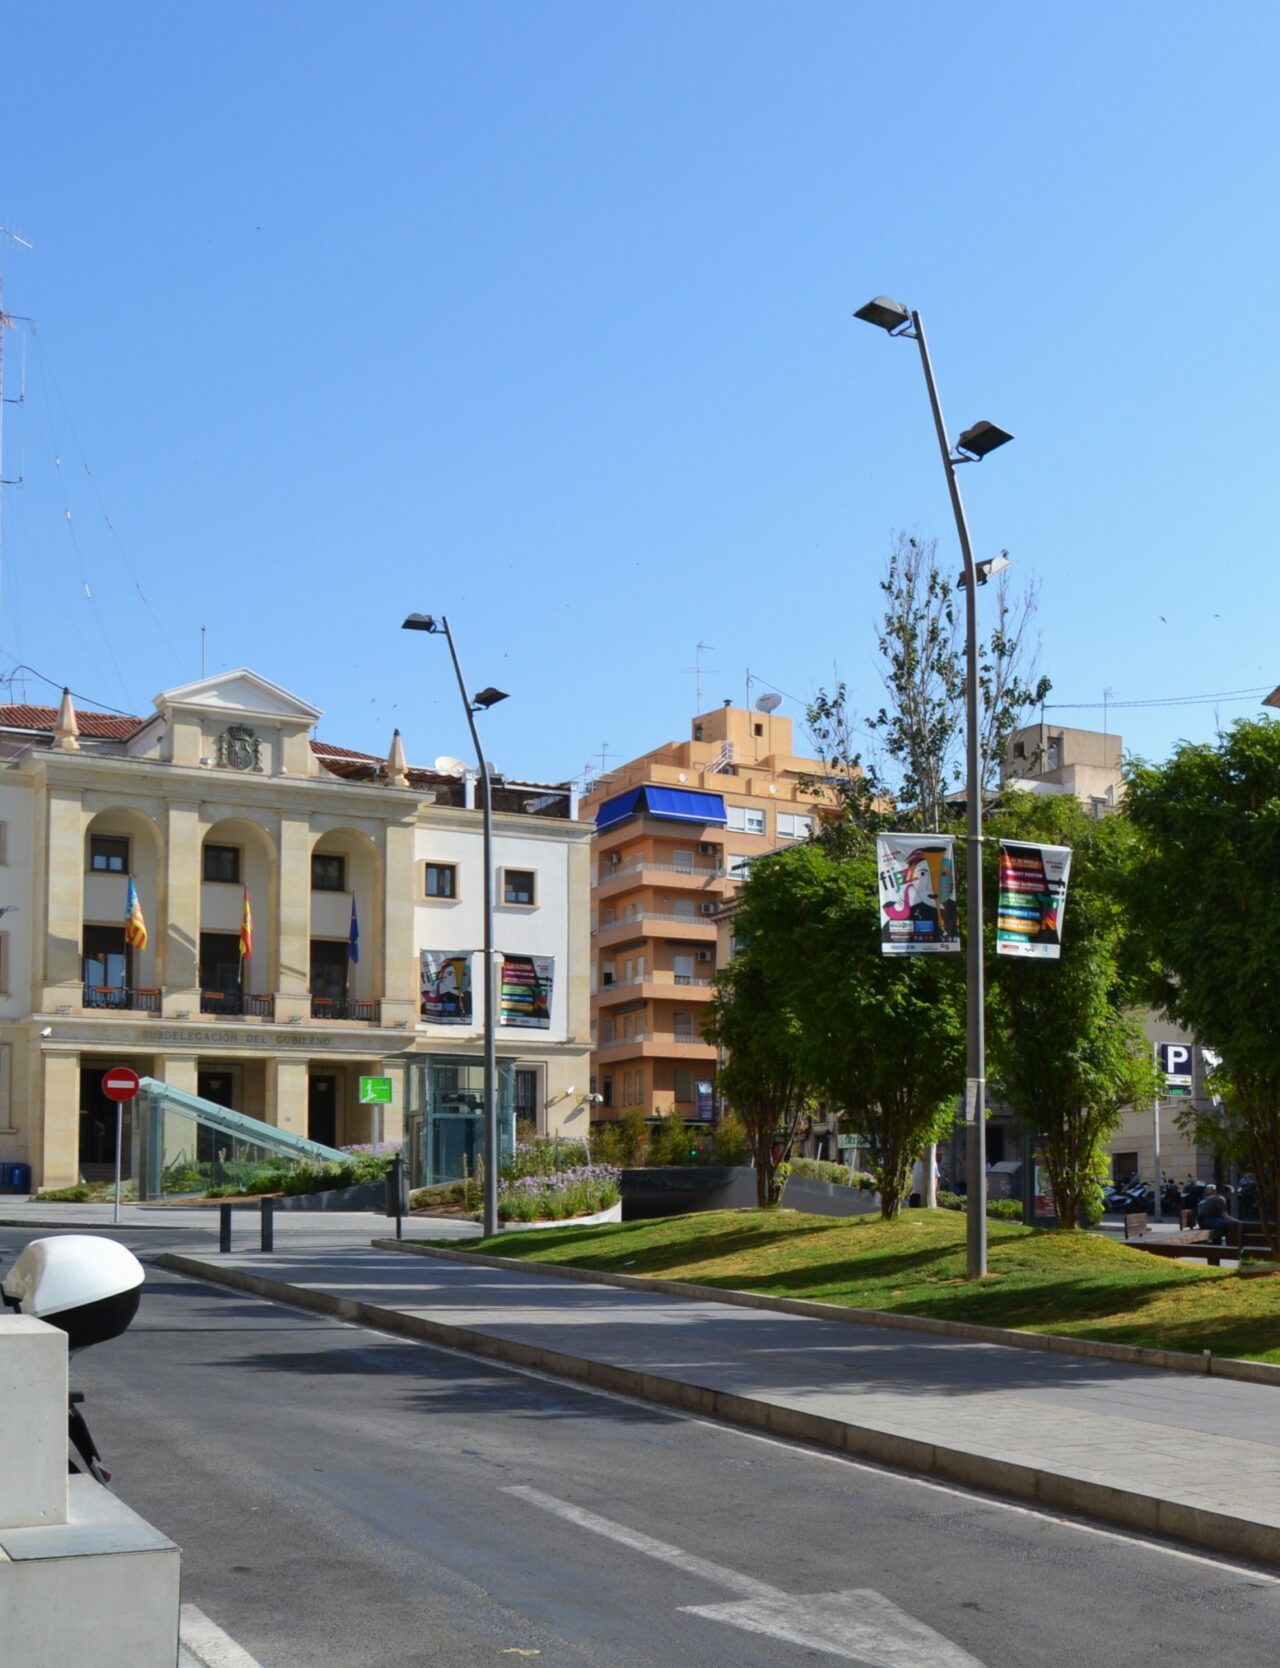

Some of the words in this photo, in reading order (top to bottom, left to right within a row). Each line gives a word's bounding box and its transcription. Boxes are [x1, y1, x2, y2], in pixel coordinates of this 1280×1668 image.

[246, 1034, 267, 1044] DEL
[276, 1035, 331, 1045] GOBIERNO
[1168, 1046, 1188, 1073] P
